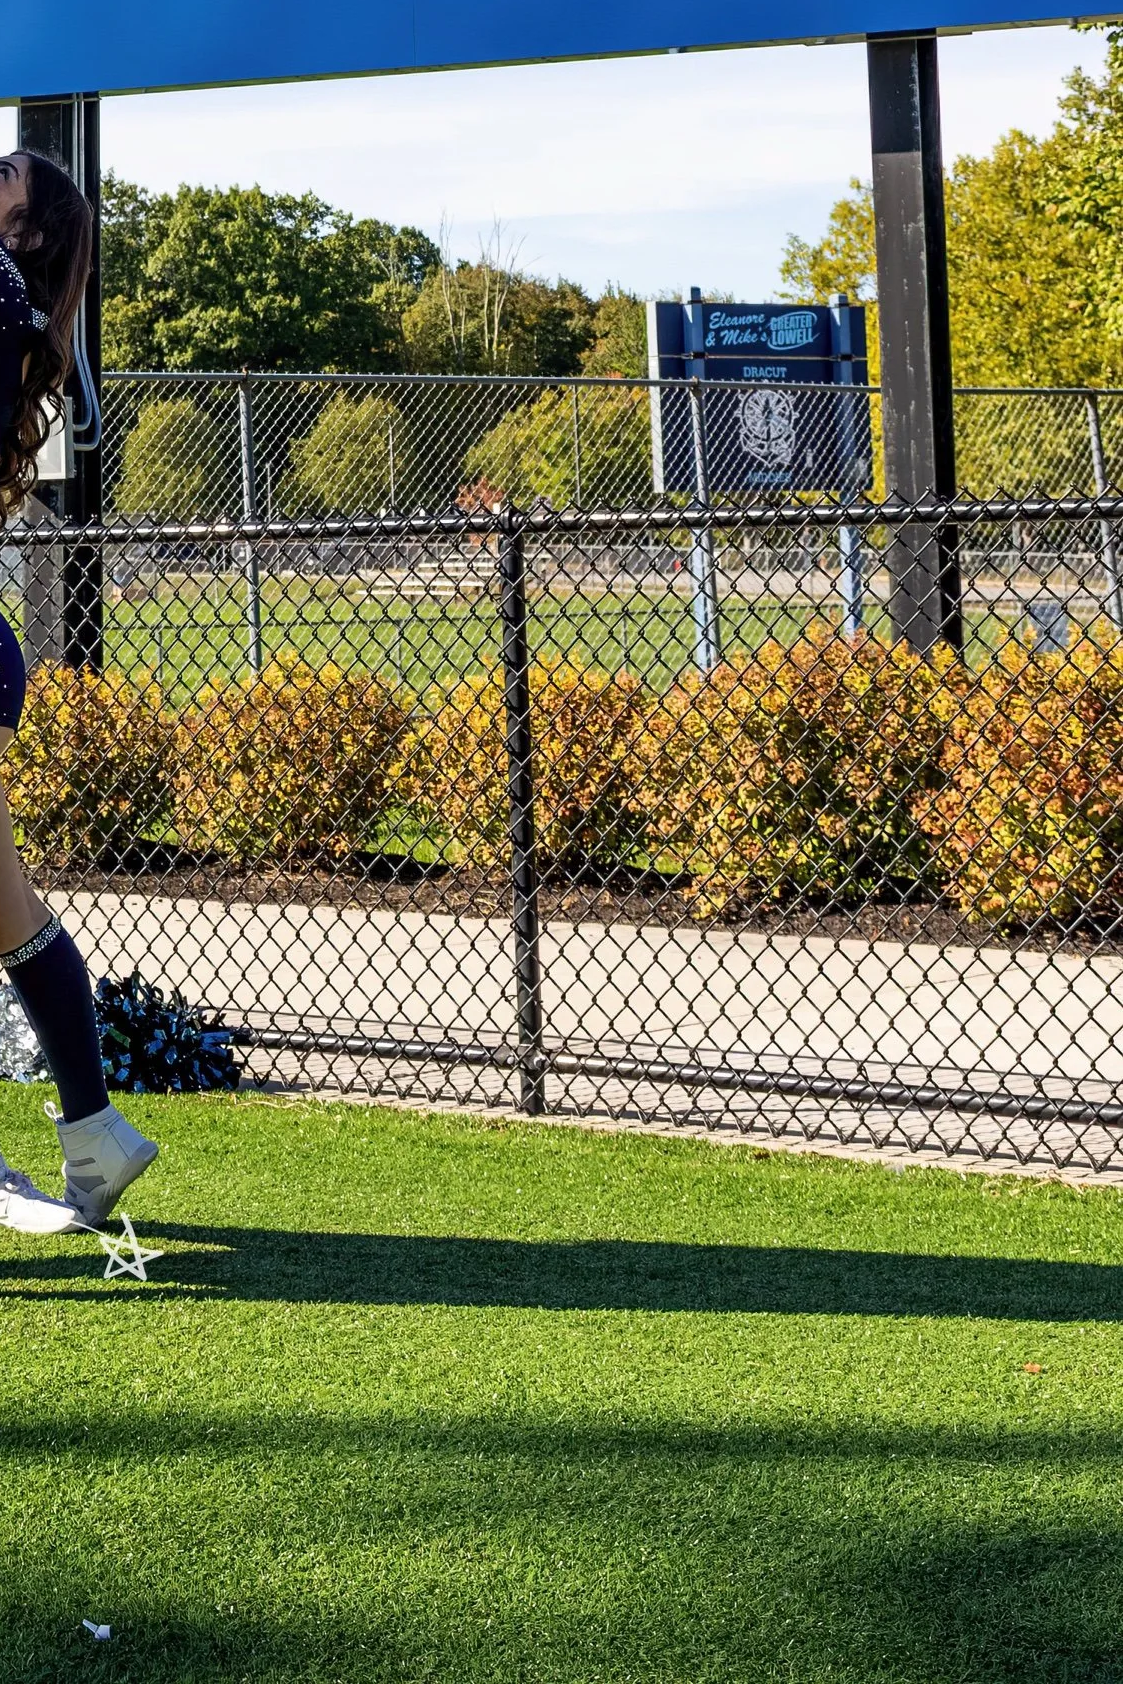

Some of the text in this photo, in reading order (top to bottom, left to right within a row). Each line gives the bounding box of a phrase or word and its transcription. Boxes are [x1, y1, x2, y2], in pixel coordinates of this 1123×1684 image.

[709, 311, 766, 330] Eleanore
[770, 315, 813, 332] GREATER
[705, 327, 768, 347] & Mike's
[772, 328, 814, 346] LOWELL
[743, 366, 788, 378] DRACUT
